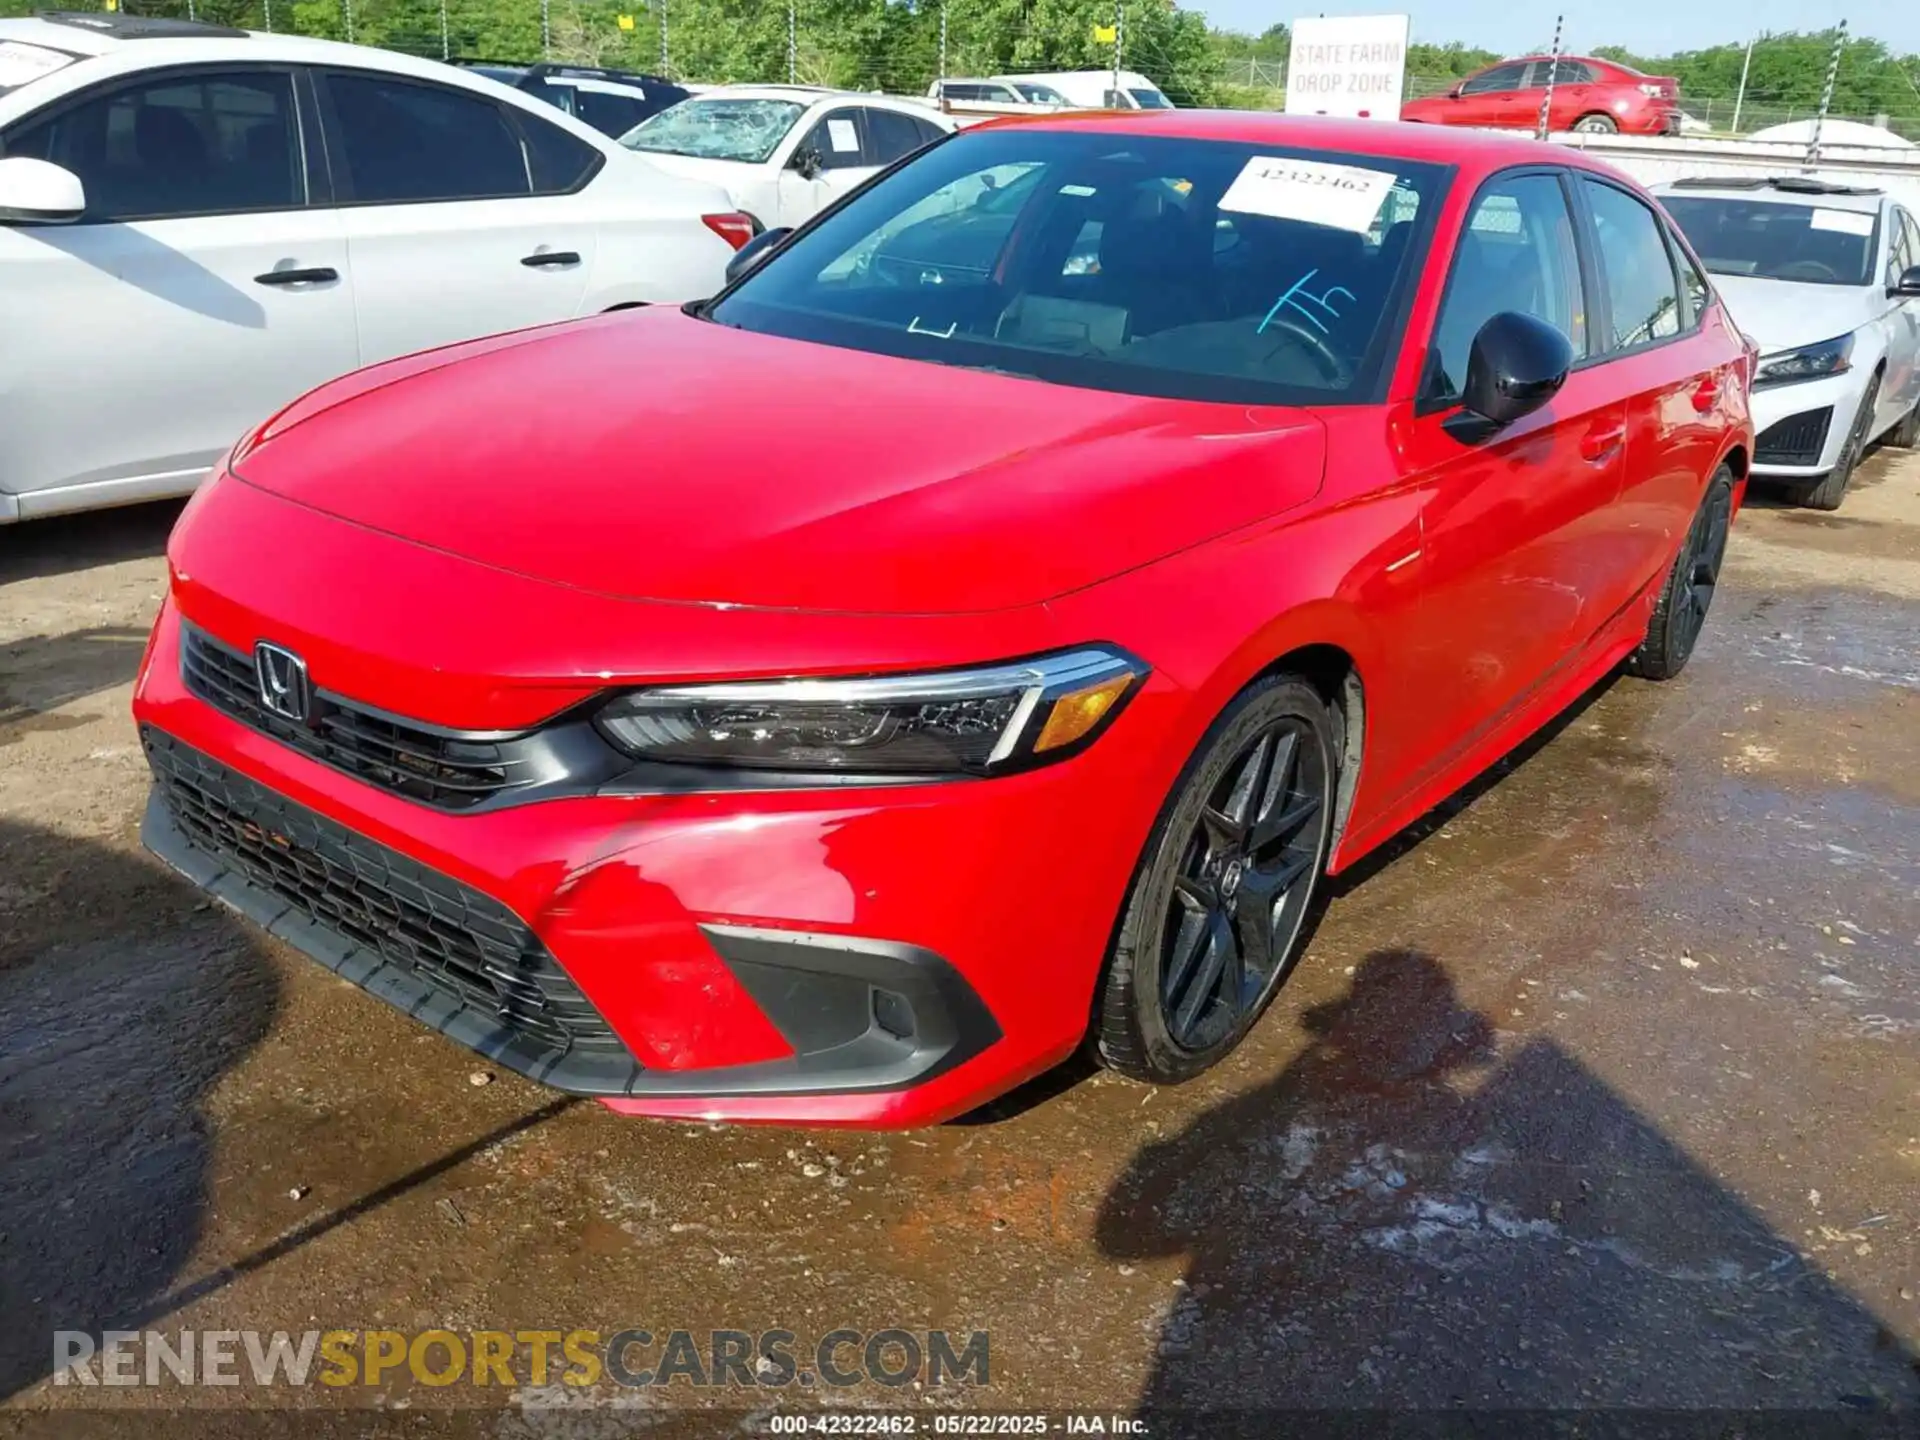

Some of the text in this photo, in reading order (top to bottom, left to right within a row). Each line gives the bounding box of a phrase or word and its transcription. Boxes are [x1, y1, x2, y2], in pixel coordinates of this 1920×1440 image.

[1295, 41, 1400, 64] STATE FARM
[1295, 73, 1393, 93] DROP ZONE
[1255, 168, 1370, 192] 42322462
